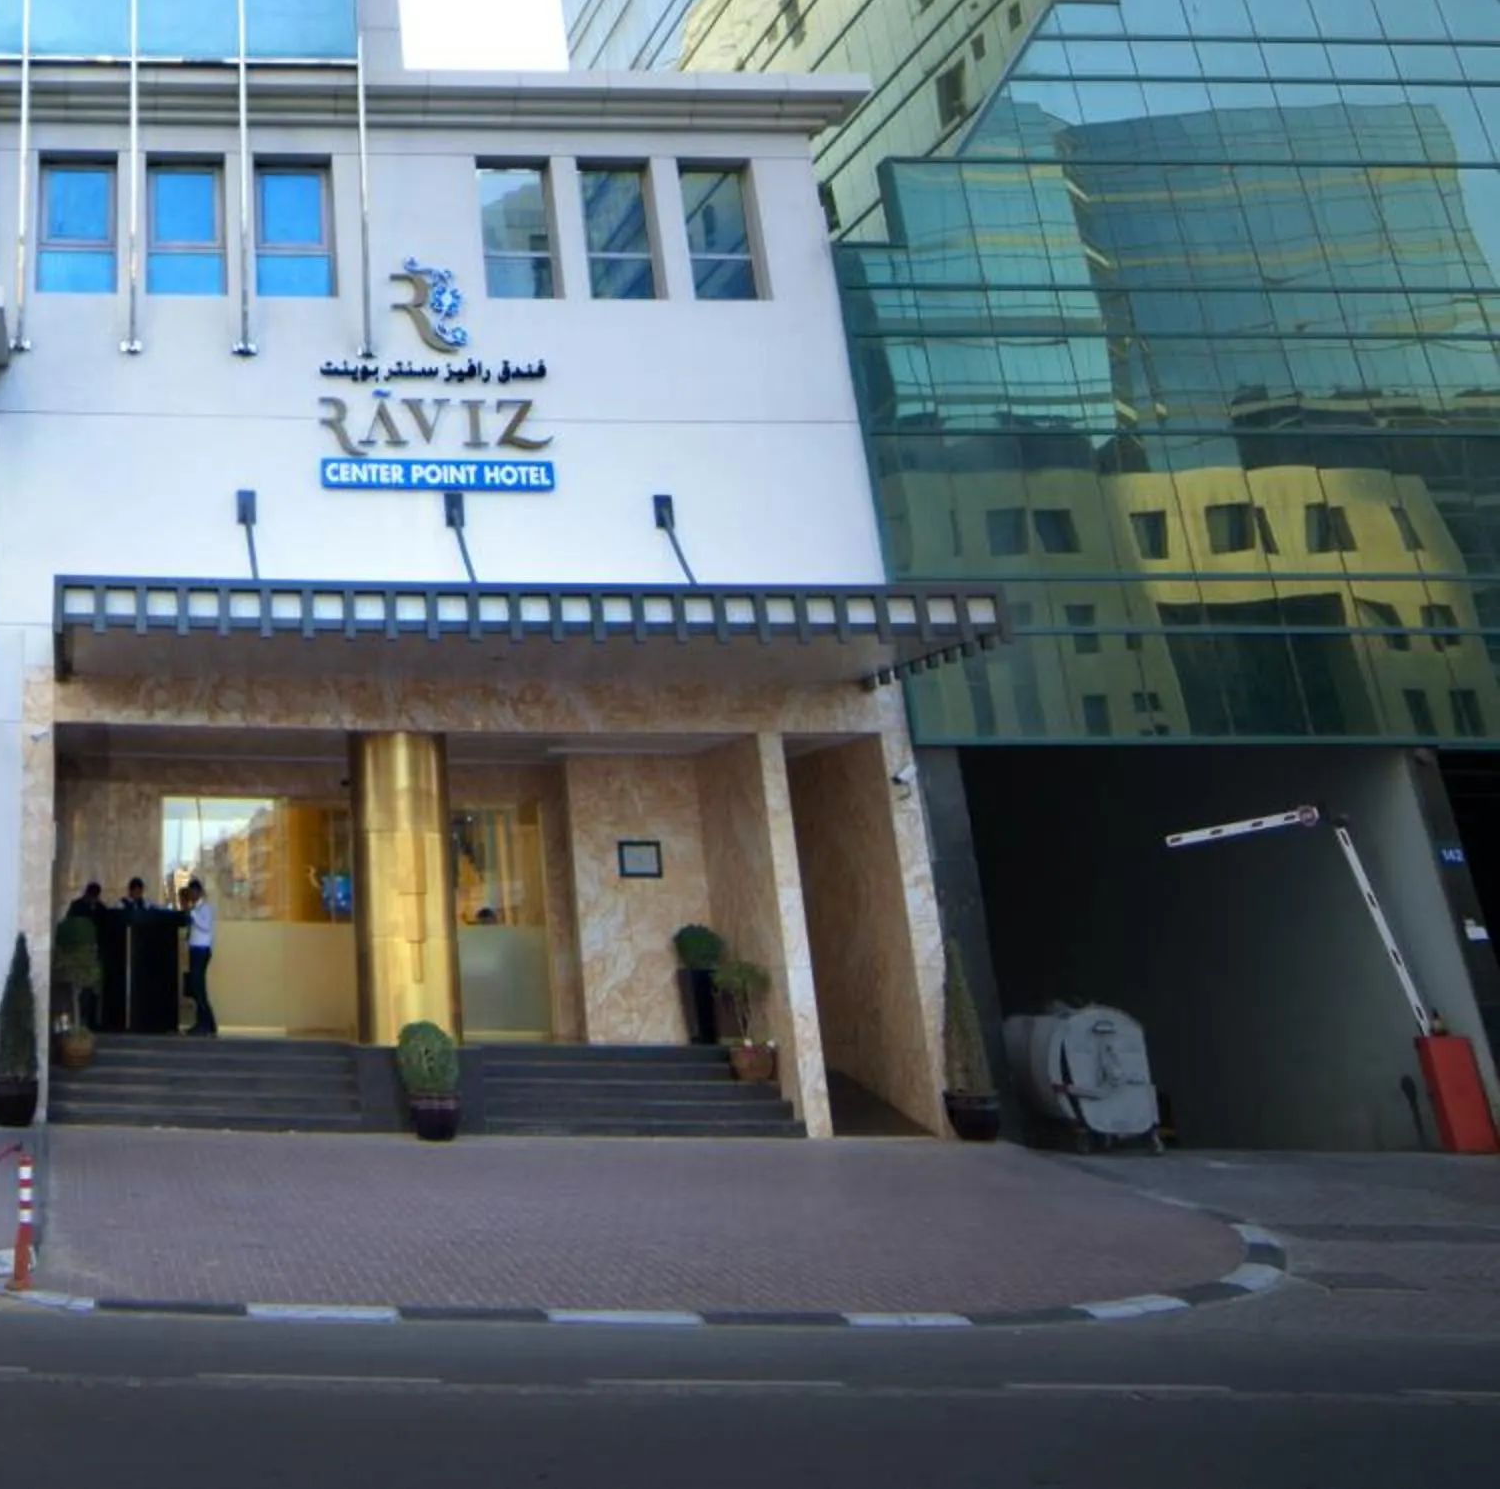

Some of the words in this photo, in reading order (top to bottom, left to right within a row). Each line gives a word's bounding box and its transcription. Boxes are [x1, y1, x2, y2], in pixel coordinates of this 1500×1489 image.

[320, 360, 379, 383] بوينت
[383, 360, 439, 382] سنتر
[443, 358, 491, 383] رافيز
[498, 358, 547, 383] فندق
[325, 462, 404, 483] CENTER
[411, 464, 477, 485] POINT
[484, 466, 551, 486] HOTEL
